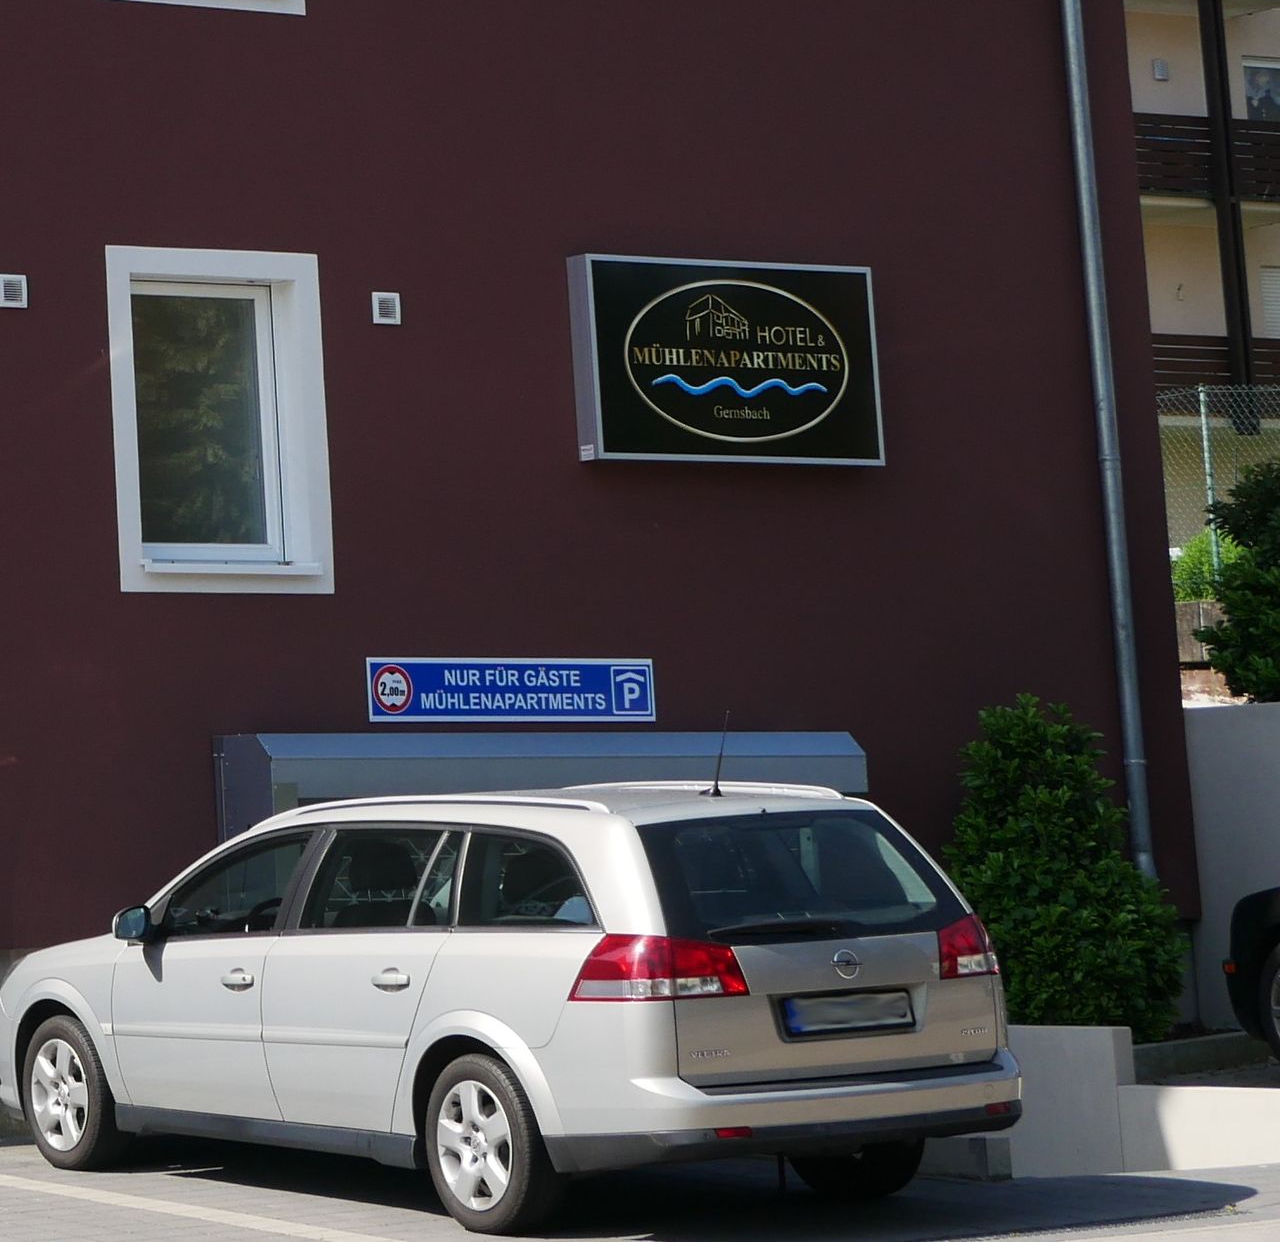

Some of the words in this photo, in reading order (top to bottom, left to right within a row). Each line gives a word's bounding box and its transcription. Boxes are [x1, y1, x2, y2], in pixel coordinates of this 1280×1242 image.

[757, 326, 814, 347] HOTEL
[817, 335, 826, 347] &
[632, 343, 841, 372] MÜHLENAPARTMENTS
[713, 405, 771, 421] Gernsbach
[444, 669, 480, 686] NUR
[485, 666, 518, 686] FÜR
[524, 666, 581, 687] GÄSTE
[420, 689, 606, 710] MÜHLENAPARTMENTS
[623, 682, 640, 708] P
